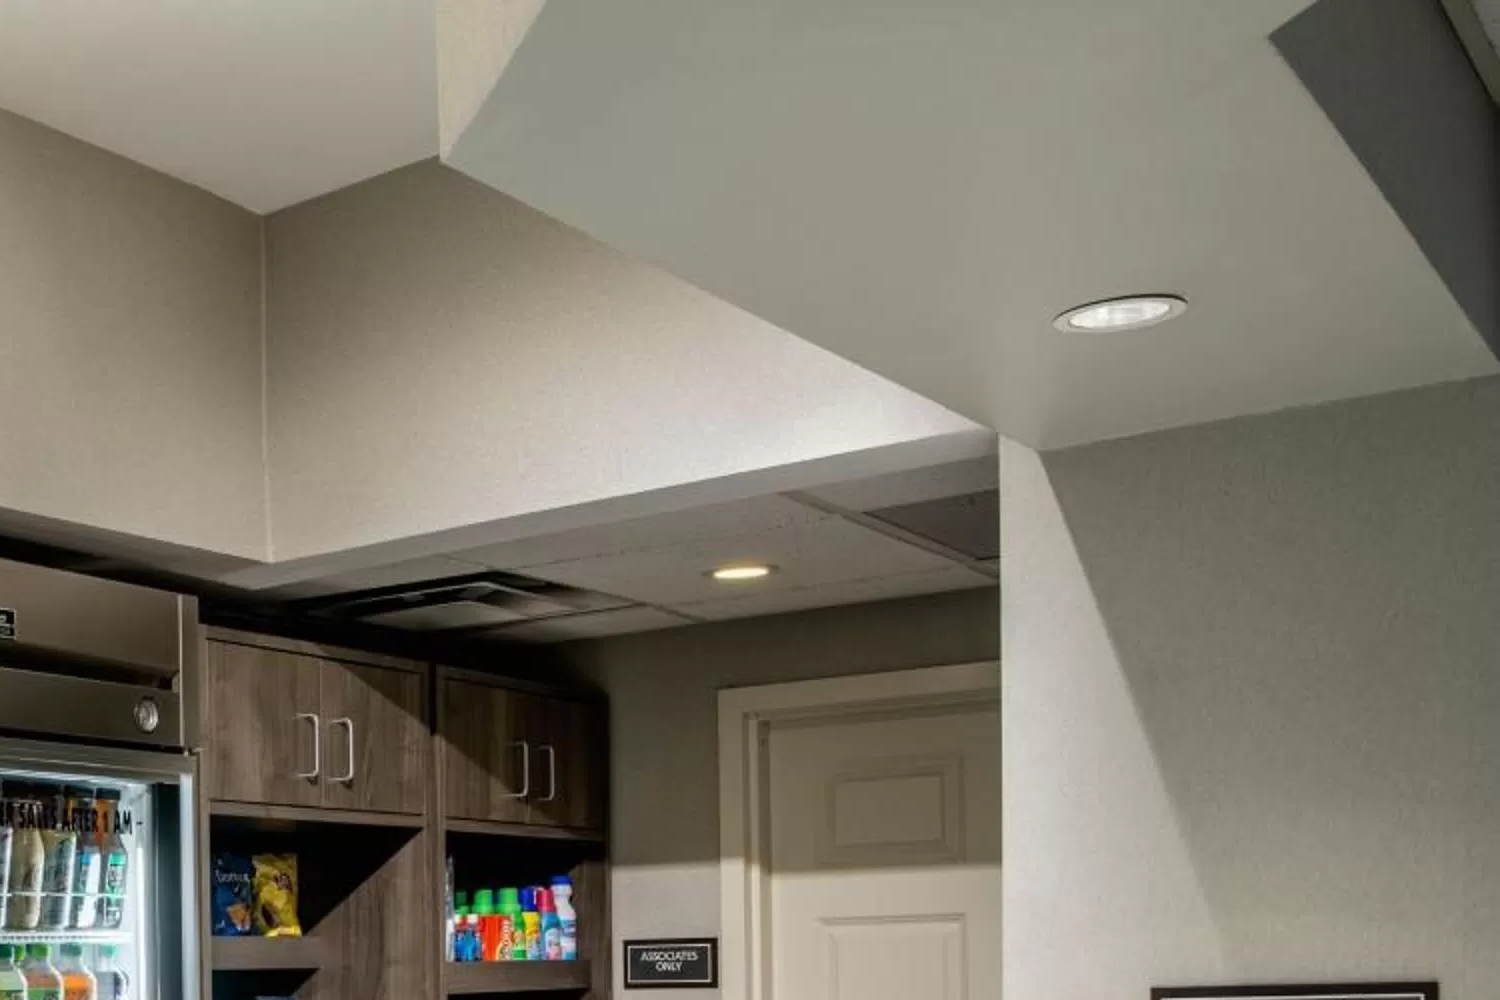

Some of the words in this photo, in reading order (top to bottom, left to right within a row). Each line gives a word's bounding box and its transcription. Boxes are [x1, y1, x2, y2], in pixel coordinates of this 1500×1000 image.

[114, 808, 133, 834] AM
[640, 951, 699, 961] ASSOCIATES
[655, 961, 683, 972] ONLY
